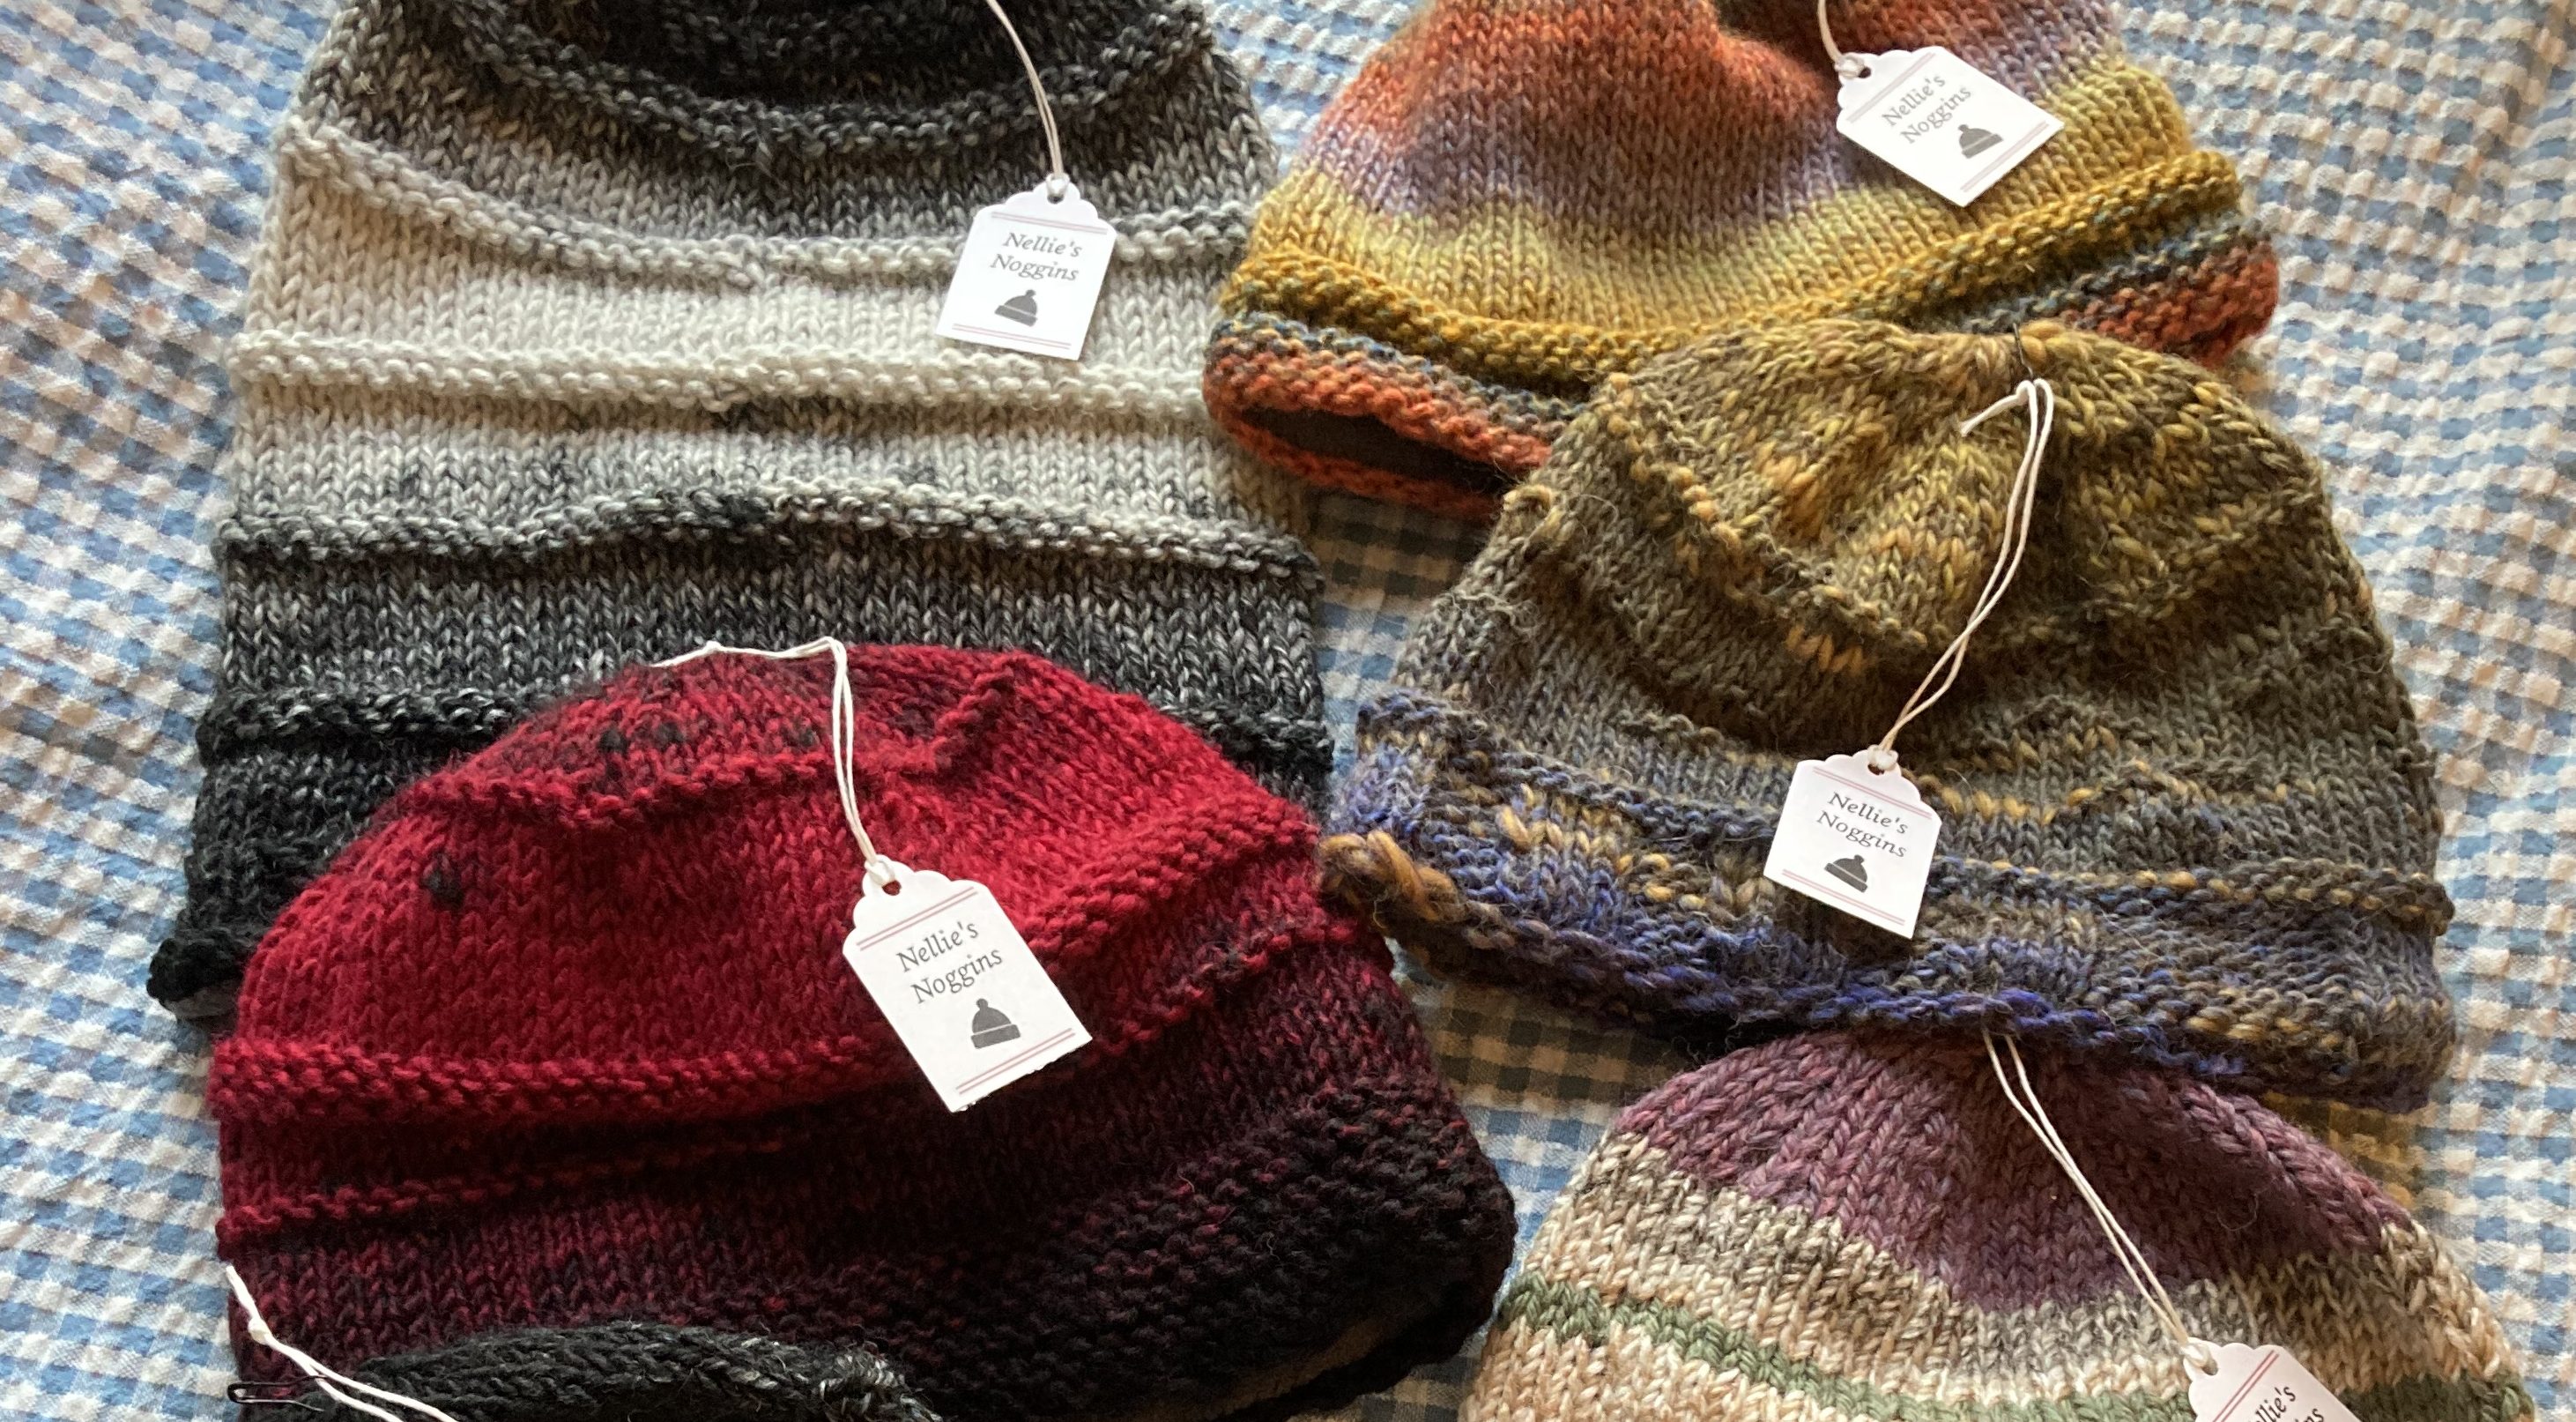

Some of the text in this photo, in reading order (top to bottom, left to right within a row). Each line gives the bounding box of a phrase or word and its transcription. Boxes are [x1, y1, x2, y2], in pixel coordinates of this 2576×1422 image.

[1882, 75, 1946, 127] Nellie's
[1900, 86, 1972, 144] Noggins
[990, 254, 1080, 280] Noggins
[1002, 233, 1083, 257] Nellie's
[1816, 810, 1908, 858] Noggins
[1827, 791, 1909, 834] Nellie's
[896, 921, 979, 973] Nellie's
[910, 949, 1003, 1004] Noggins
[2249, 1386, 2296, 1422] llie's
